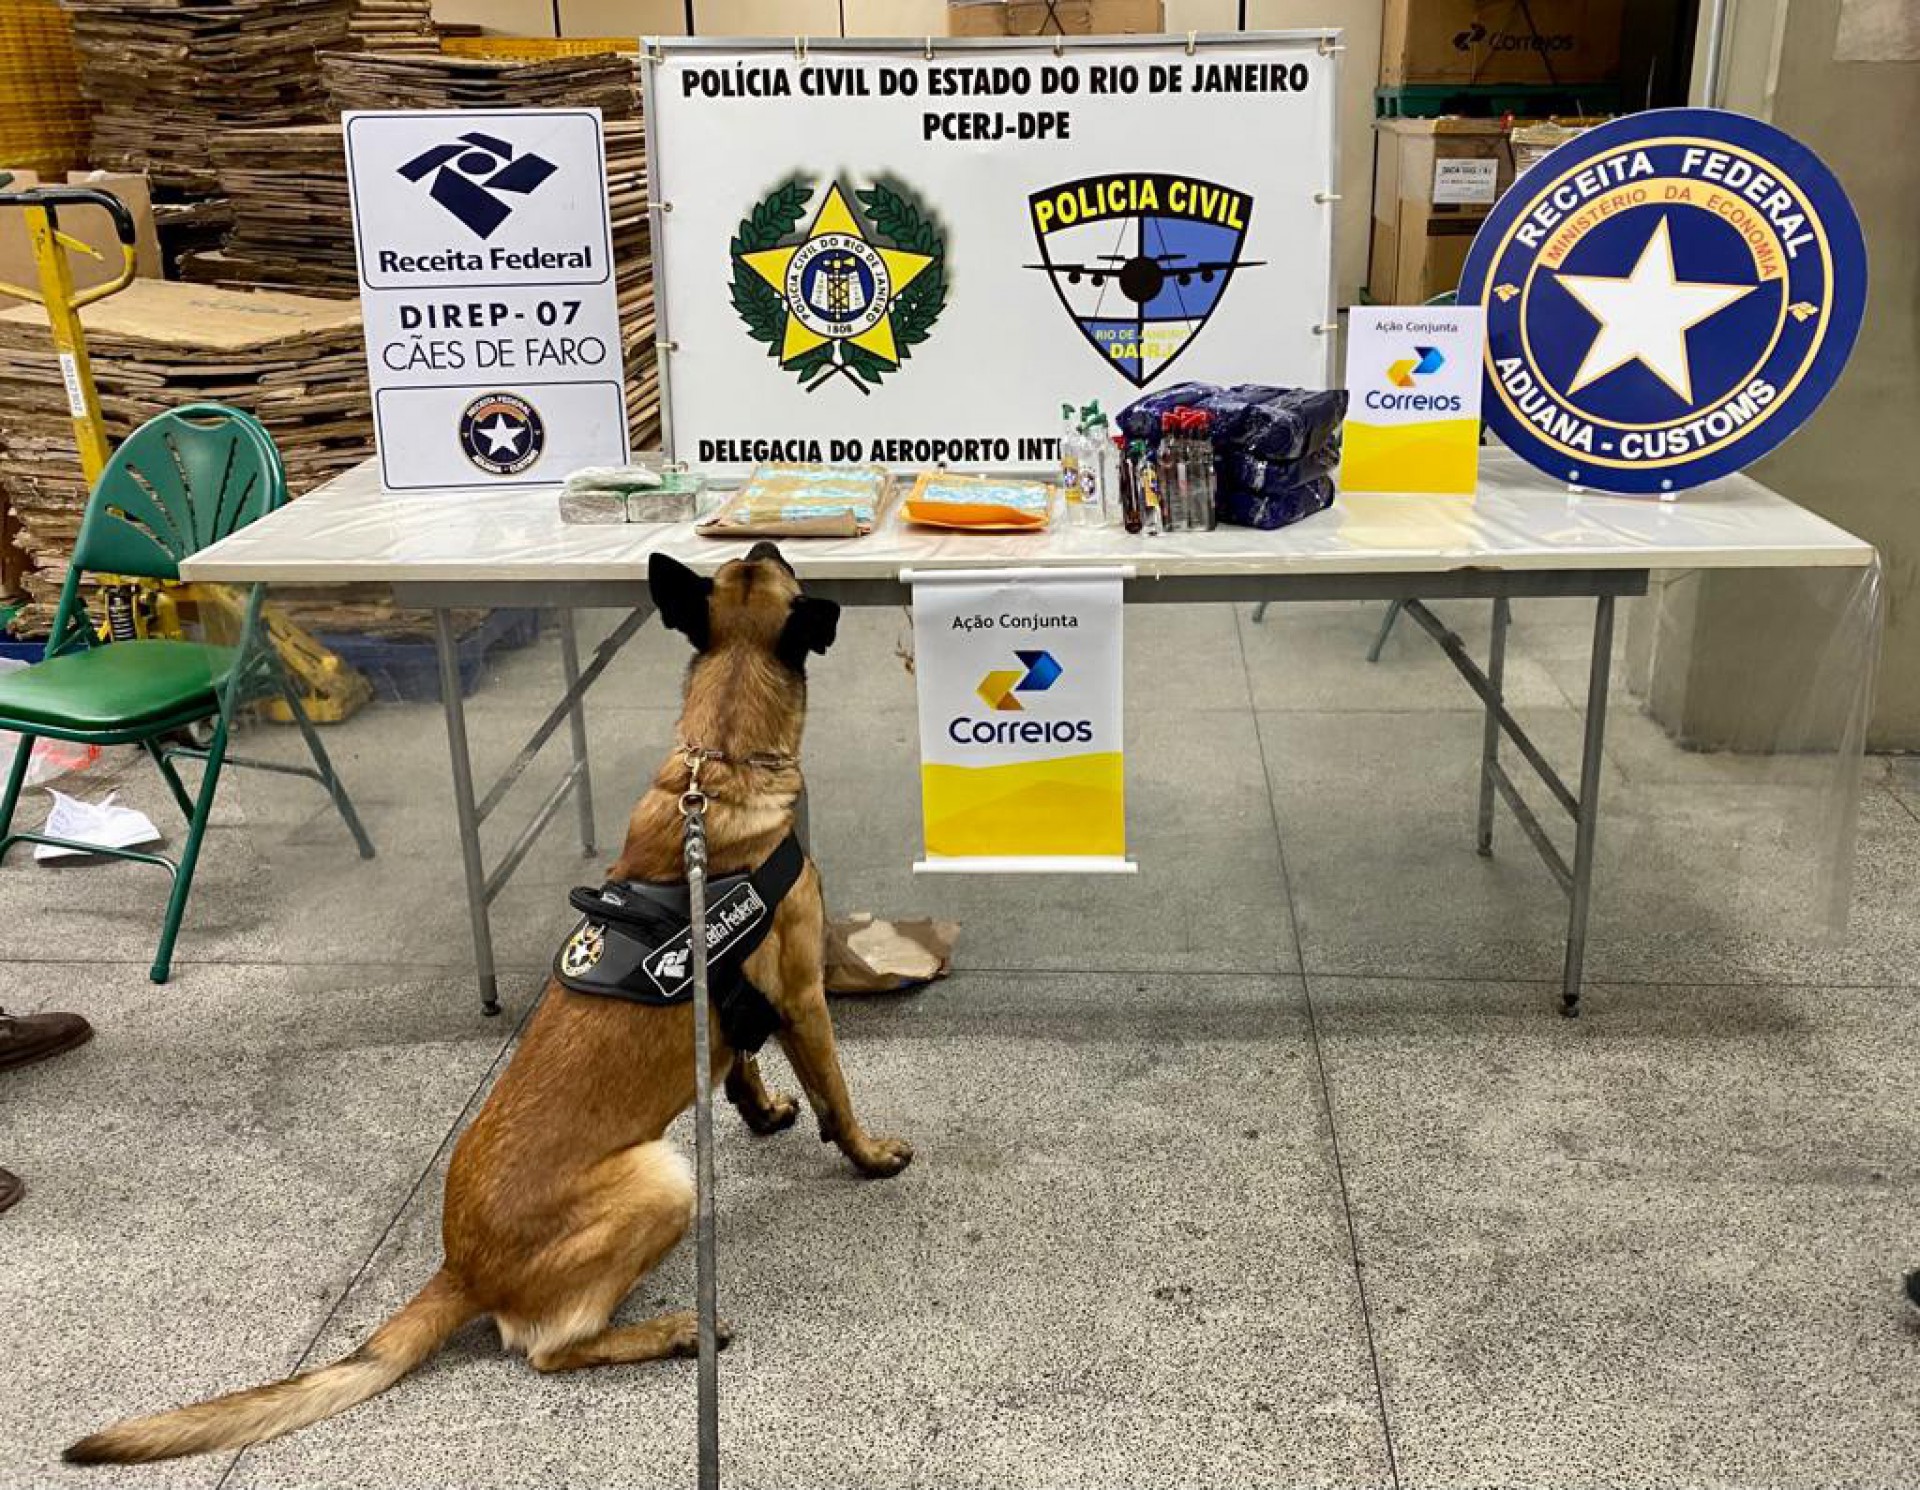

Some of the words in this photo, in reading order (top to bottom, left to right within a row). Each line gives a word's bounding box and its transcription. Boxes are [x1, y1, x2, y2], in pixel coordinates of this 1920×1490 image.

[682, 61, 791, 97] POLÍCIA
[799, 68, 870, 97] CIVIL
[879, 68, 918, 97] DO
[928, 67, 1031, 96] ESTADO
[1041, 66, 1080, 95] DO
[1089, 66, 1139, 94] RIO
[1149, 65, 1182, 93] DE
[1191, 64, 1309, 93] JANEIRO
[924, 112, 1069, 140] PCERJ-DPE
[1035, 179, 1159, 233] POLICIA
[1168, 181, 1243, 230] CIVIL
[1515, 151, 1654, 249] RECEITA
[1680, 149, 1815, 259] FEDERAL
[820, 238, 839, 248] DO
[1664, 185, 1692, 201] DA
[1706, 194, 1779, 277] ECONOMIA
[379, 249, 483, 273] Receita
[490, 246, 591, 270] Federal
[536, 300, 582, 326] 07
[1376, 322, 1403, 332] Ação
[1406, 321, 1458, 333] Conjunta
[383, 335, 466, 370] CÃES
[476, 338, 515, 367] DE
[525, 336, 606, 366] FARO
[1365, 390, 1462, 411] Correios
[1495, 356, 1594, 454] ADUANA
[1621, 377, 1778, 461] CUSTOMS
[699, 439, 822, 462] DELEGACIA
[830, 440, 863, 462] DO
[870, 438, 1010, 462] AEROPORTO
[952, 615, 994, 632] Ação
[999, 613, 1079, 631] Conjunta
[949, 717, 1093, 744] Correios
